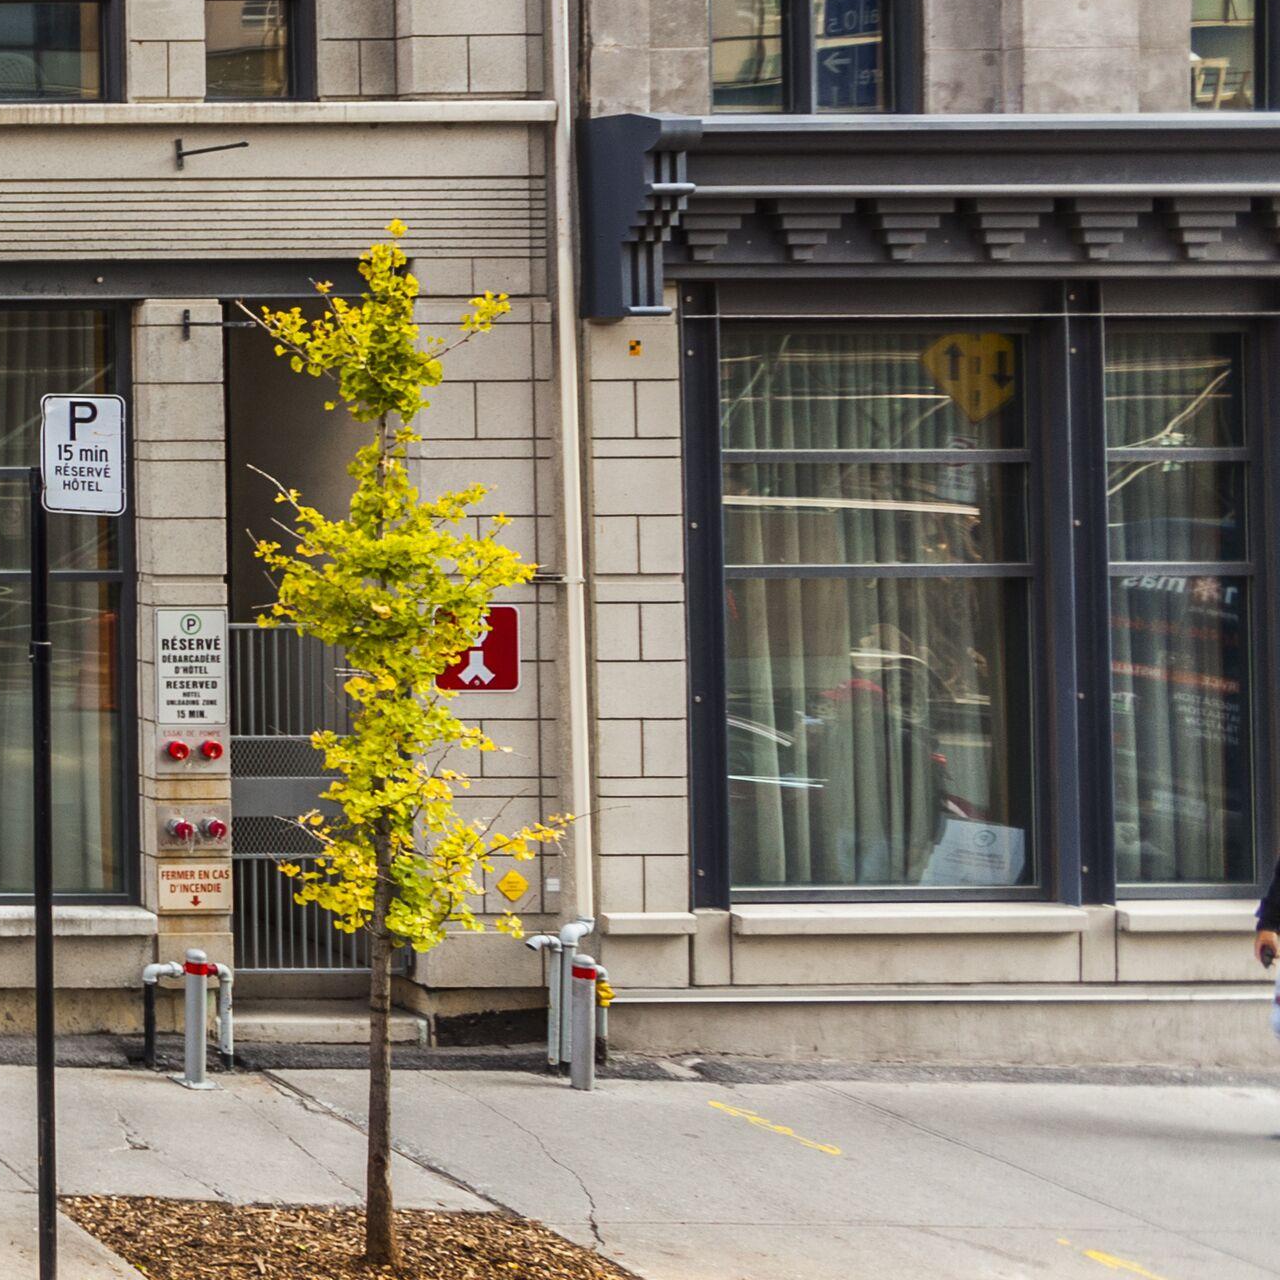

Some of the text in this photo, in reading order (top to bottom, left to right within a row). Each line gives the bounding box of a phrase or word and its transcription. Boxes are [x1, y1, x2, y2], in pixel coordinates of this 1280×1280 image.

[69, 401, 98, 441] P
[57, 444, 109, 462] 15 min
[55, 463, 111, 478] RÉSERVÉ
[62, 478, 103, 492] HÔTEL
[186, 618, 197, 631] P
[161, 635, 222, 651] RÉSERVÉ
[174, 665, 209, 675] D'HÔTEL
[166, 681, 218, 689] RESERVED
[177, 710, 186, 719] 15
[161, 869, 230, 880] FERMER EN CAS
